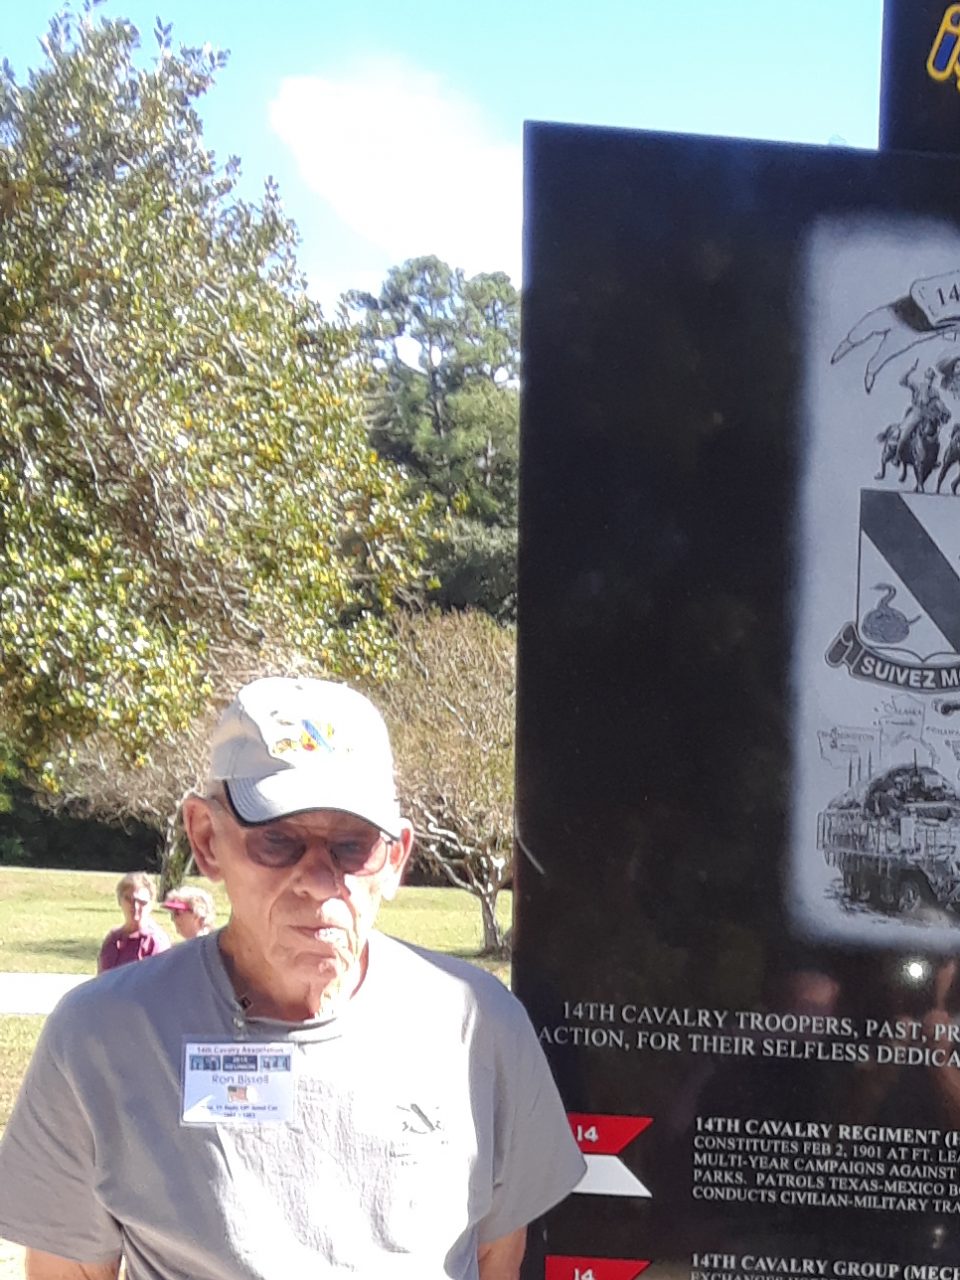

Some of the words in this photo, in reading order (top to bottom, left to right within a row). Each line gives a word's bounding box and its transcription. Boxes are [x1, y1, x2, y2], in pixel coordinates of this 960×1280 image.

[861, 656, 936, 688] SUIVEZ
[564, 999, 614, 1022] 14TH
[621, 1003, 727, 1029] CAVALRY
[735, 1010, 858, 1037] TROOPERS,
[866, 1018, 926, 1041] PAST,
[538, 1023, 629, 1048] ACTION,
[637, 1029, 680, 1052] FOR
[688, 1032, 755, 1056] THEIR
[762, 1037, 869, 1063] SELFLESS
[577, 1125, 598, 1142] 14
[696, 1116, 739, 1133] 14TH
[744, 1119, 832, 1138] CAVALRY
[838, 1124, 940, 1144] REGIMENT
[756, 1172, 824, 1189] PATROLS
[828, 1176, 944, 1195] TEXAS-MEXICO
[692, 1252, 735, 1269] 14TH
[740, 1255, 827, 1274] CAVALRY
[832, 1260, 898, 1278] GROUP
